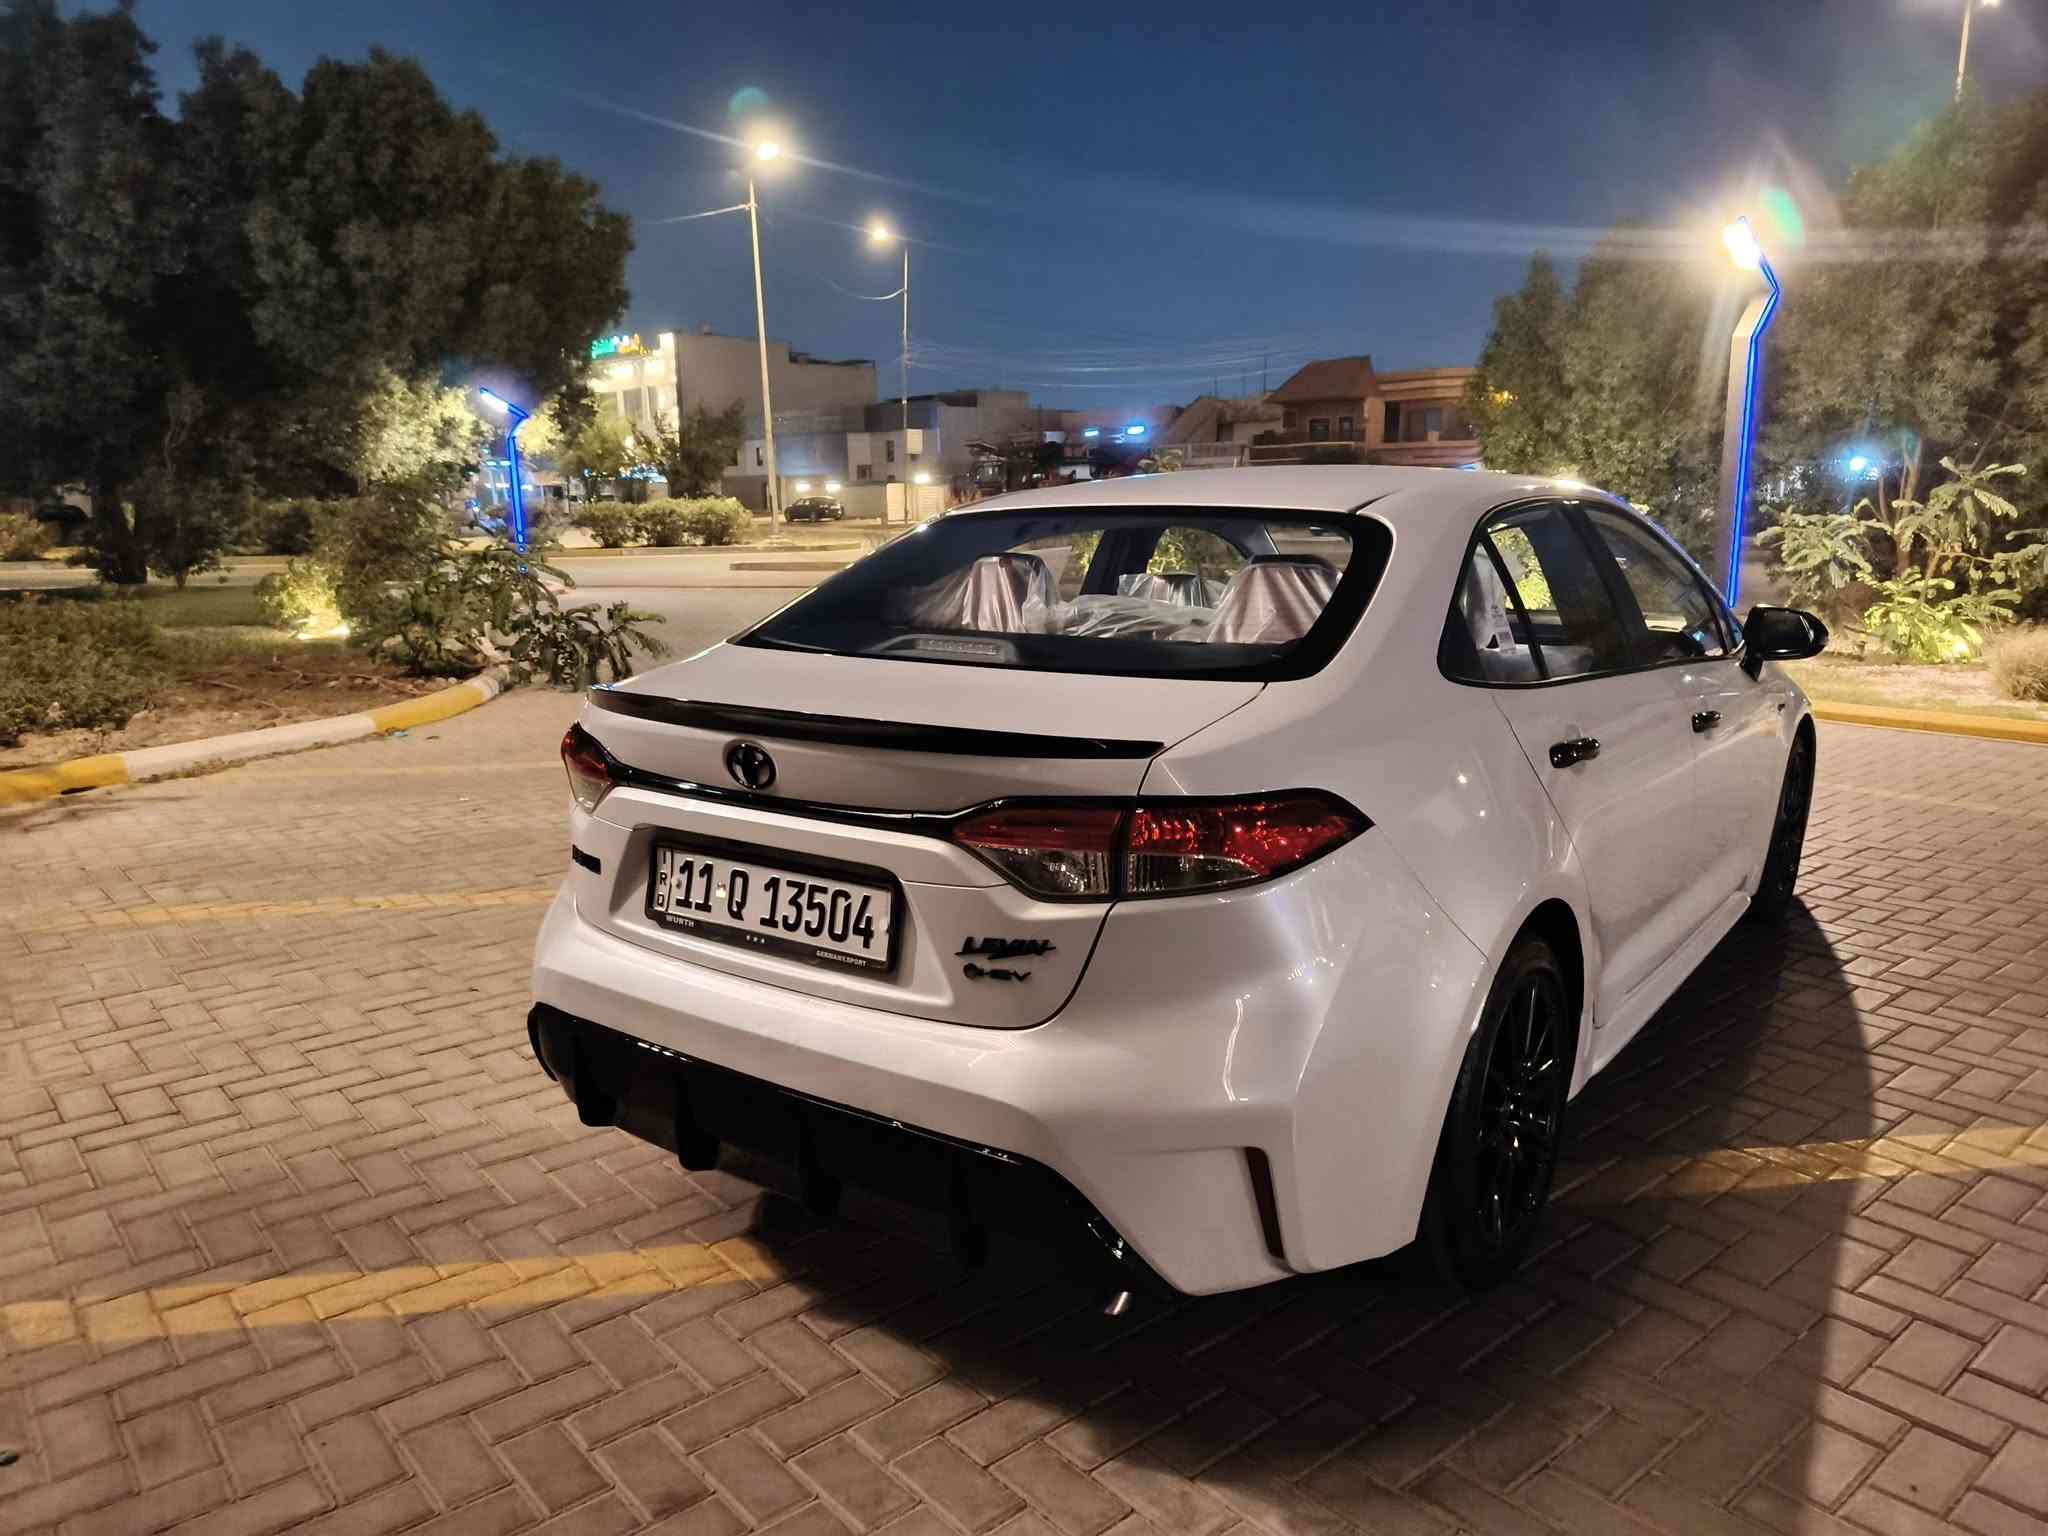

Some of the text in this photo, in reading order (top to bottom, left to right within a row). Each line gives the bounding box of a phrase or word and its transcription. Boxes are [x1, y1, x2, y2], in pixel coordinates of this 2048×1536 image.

[675, 858, 874, 949] 11 Q 13504
